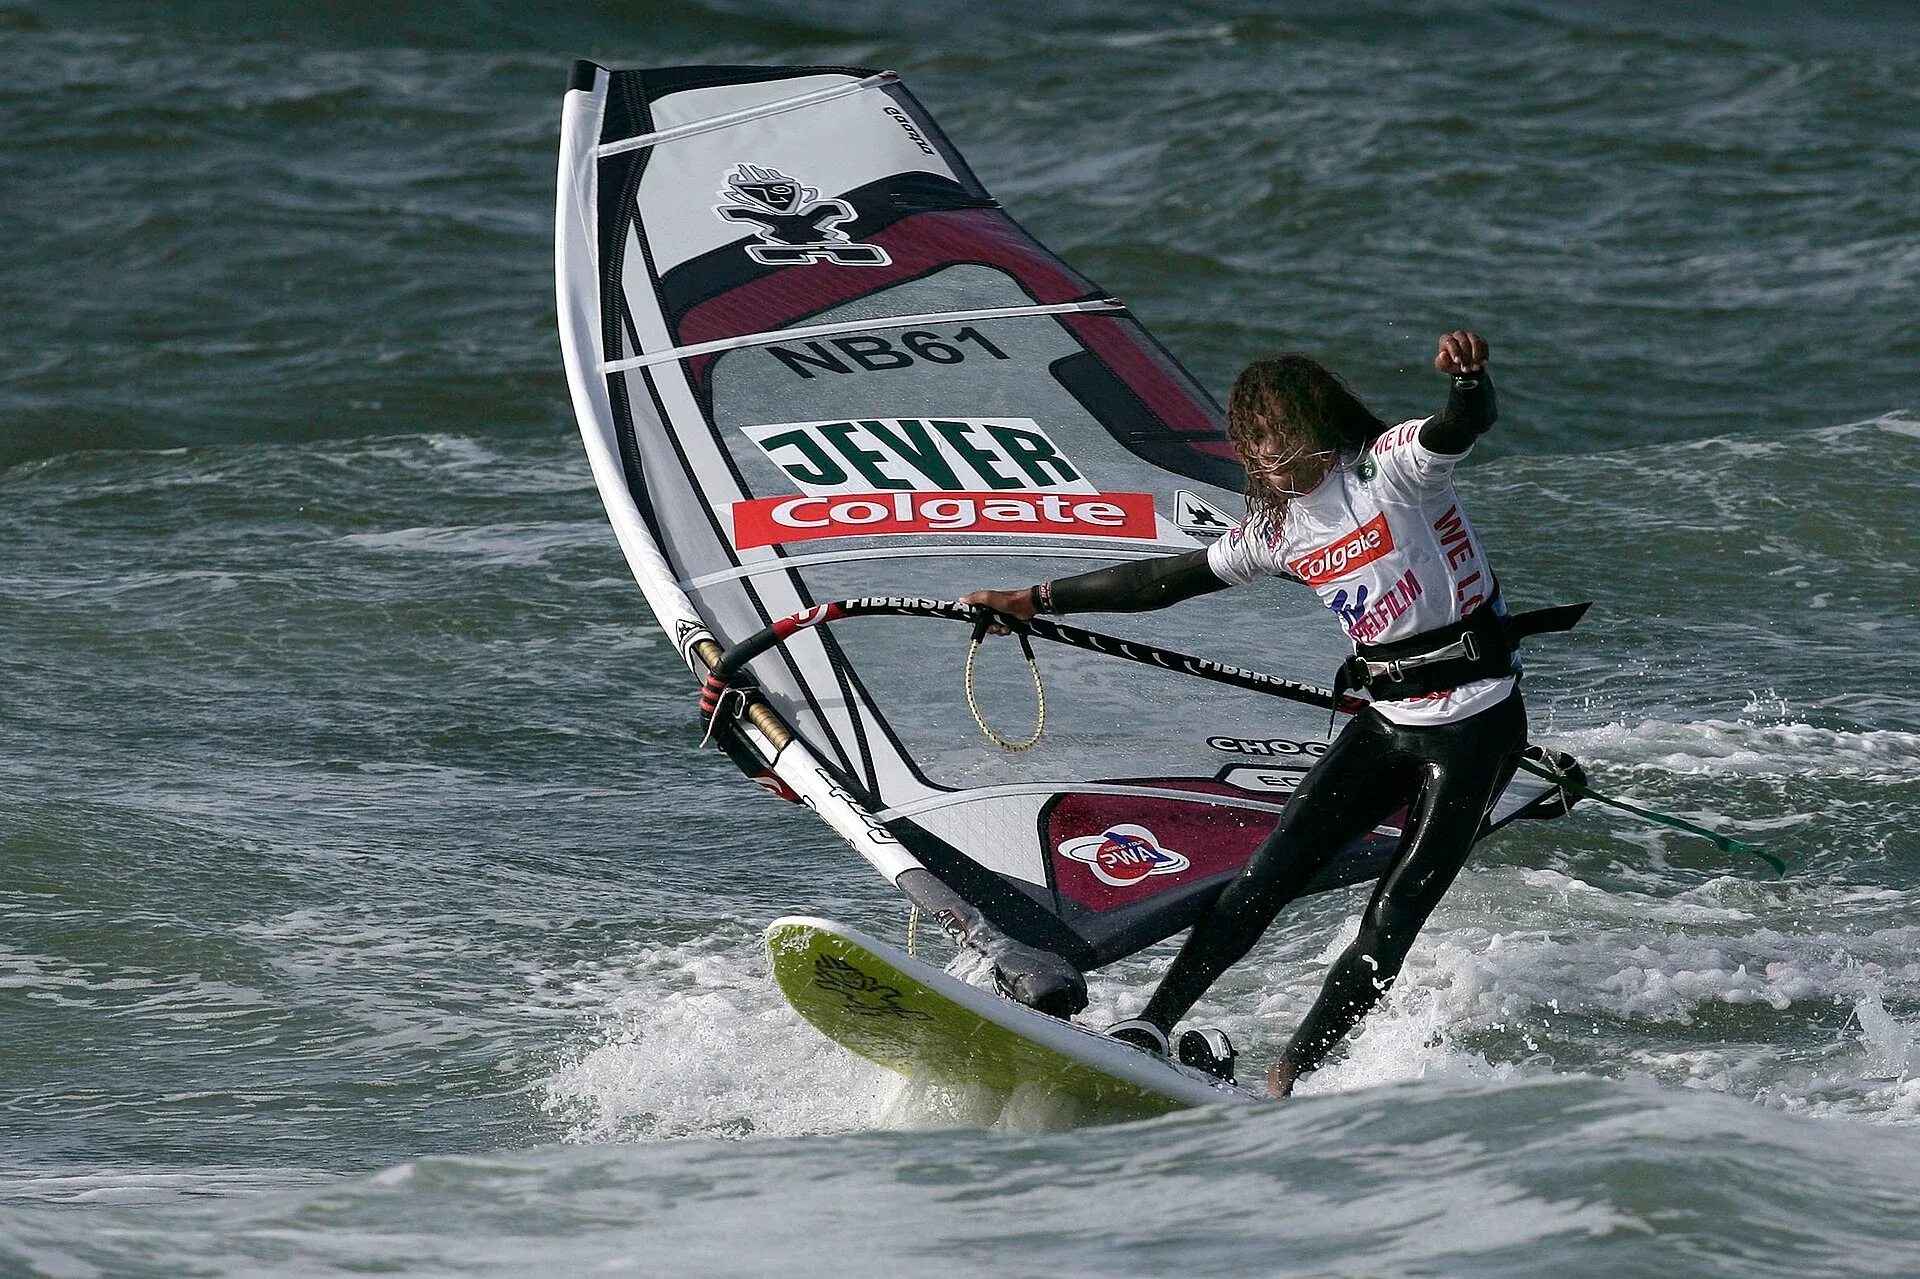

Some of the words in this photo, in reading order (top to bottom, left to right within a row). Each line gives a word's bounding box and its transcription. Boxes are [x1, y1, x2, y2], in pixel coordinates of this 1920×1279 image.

[764, 326, 1011, 379] NB61
[758, 419, 1081, 490] JEVER
[770, 492, 1126, 528] Colgate
[1295, 529, 1381, 581] Colgate
[1433, 503, 1475, 572] WE
[1099, 846, 1158, 869] PWA
